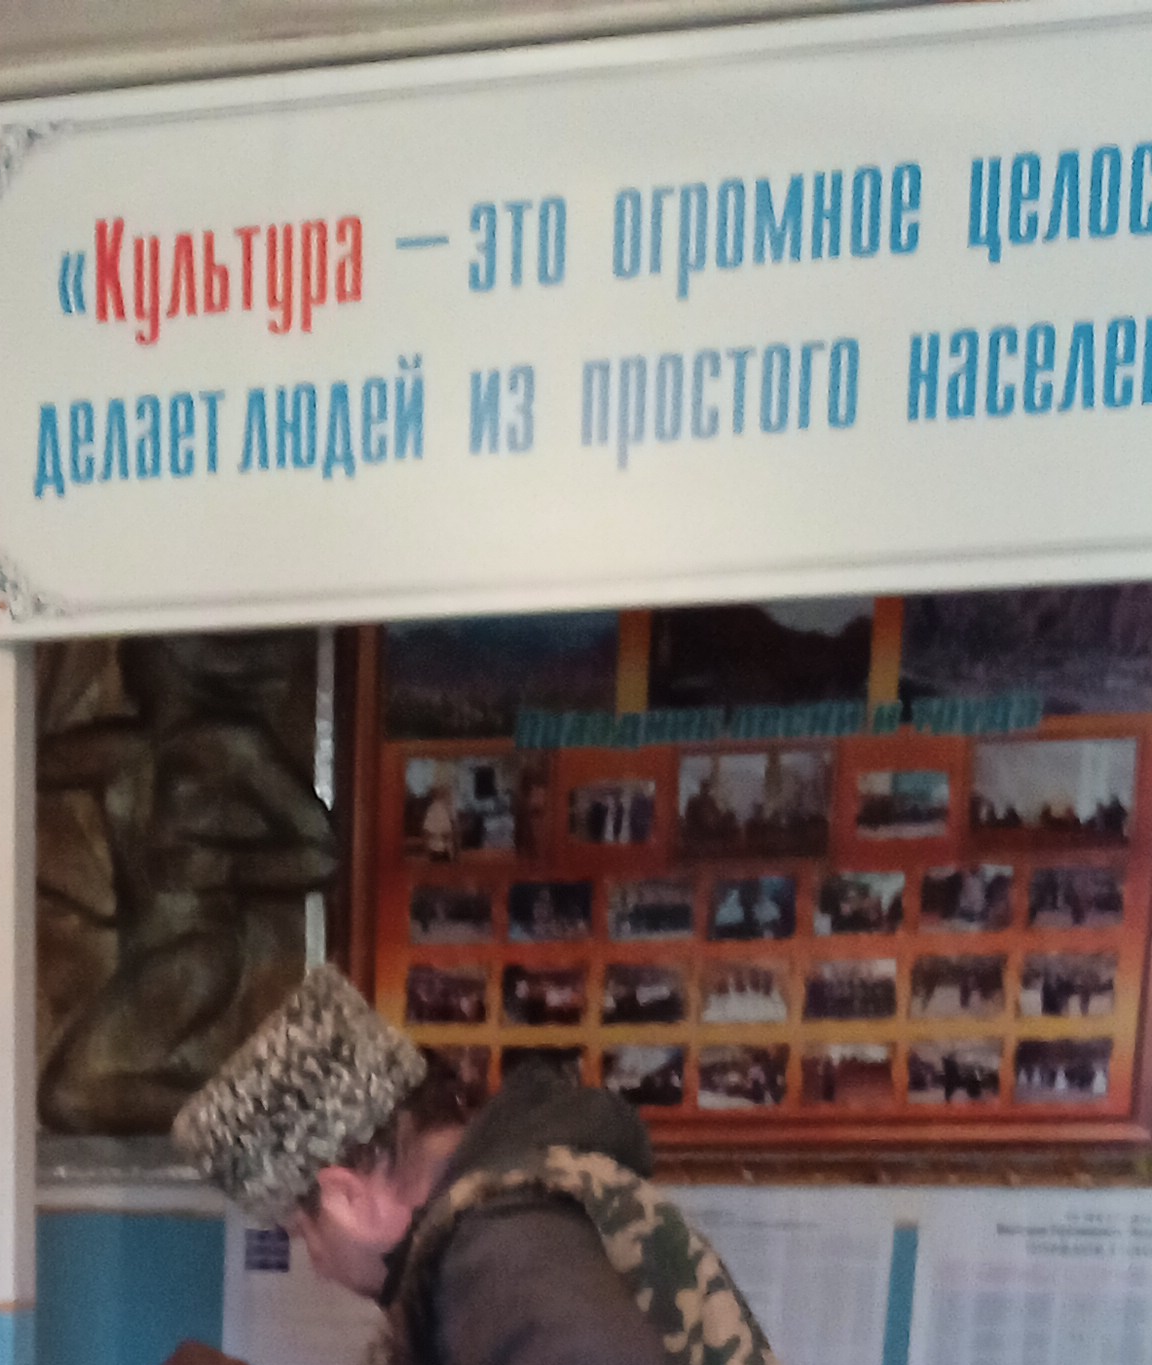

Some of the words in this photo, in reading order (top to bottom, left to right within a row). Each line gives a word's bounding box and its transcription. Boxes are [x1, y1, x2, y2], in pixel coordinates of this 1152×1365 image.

[59, 215, 364, 345] «Культура
[467, 197, 568, 292] это
[612, 162, 923, 298] огромное
[34, 389, 227, 499] делает
[240, 354, 426, 479] людей
[468, 362, 536, 456] из
[581, 336, 859, 469] простого
